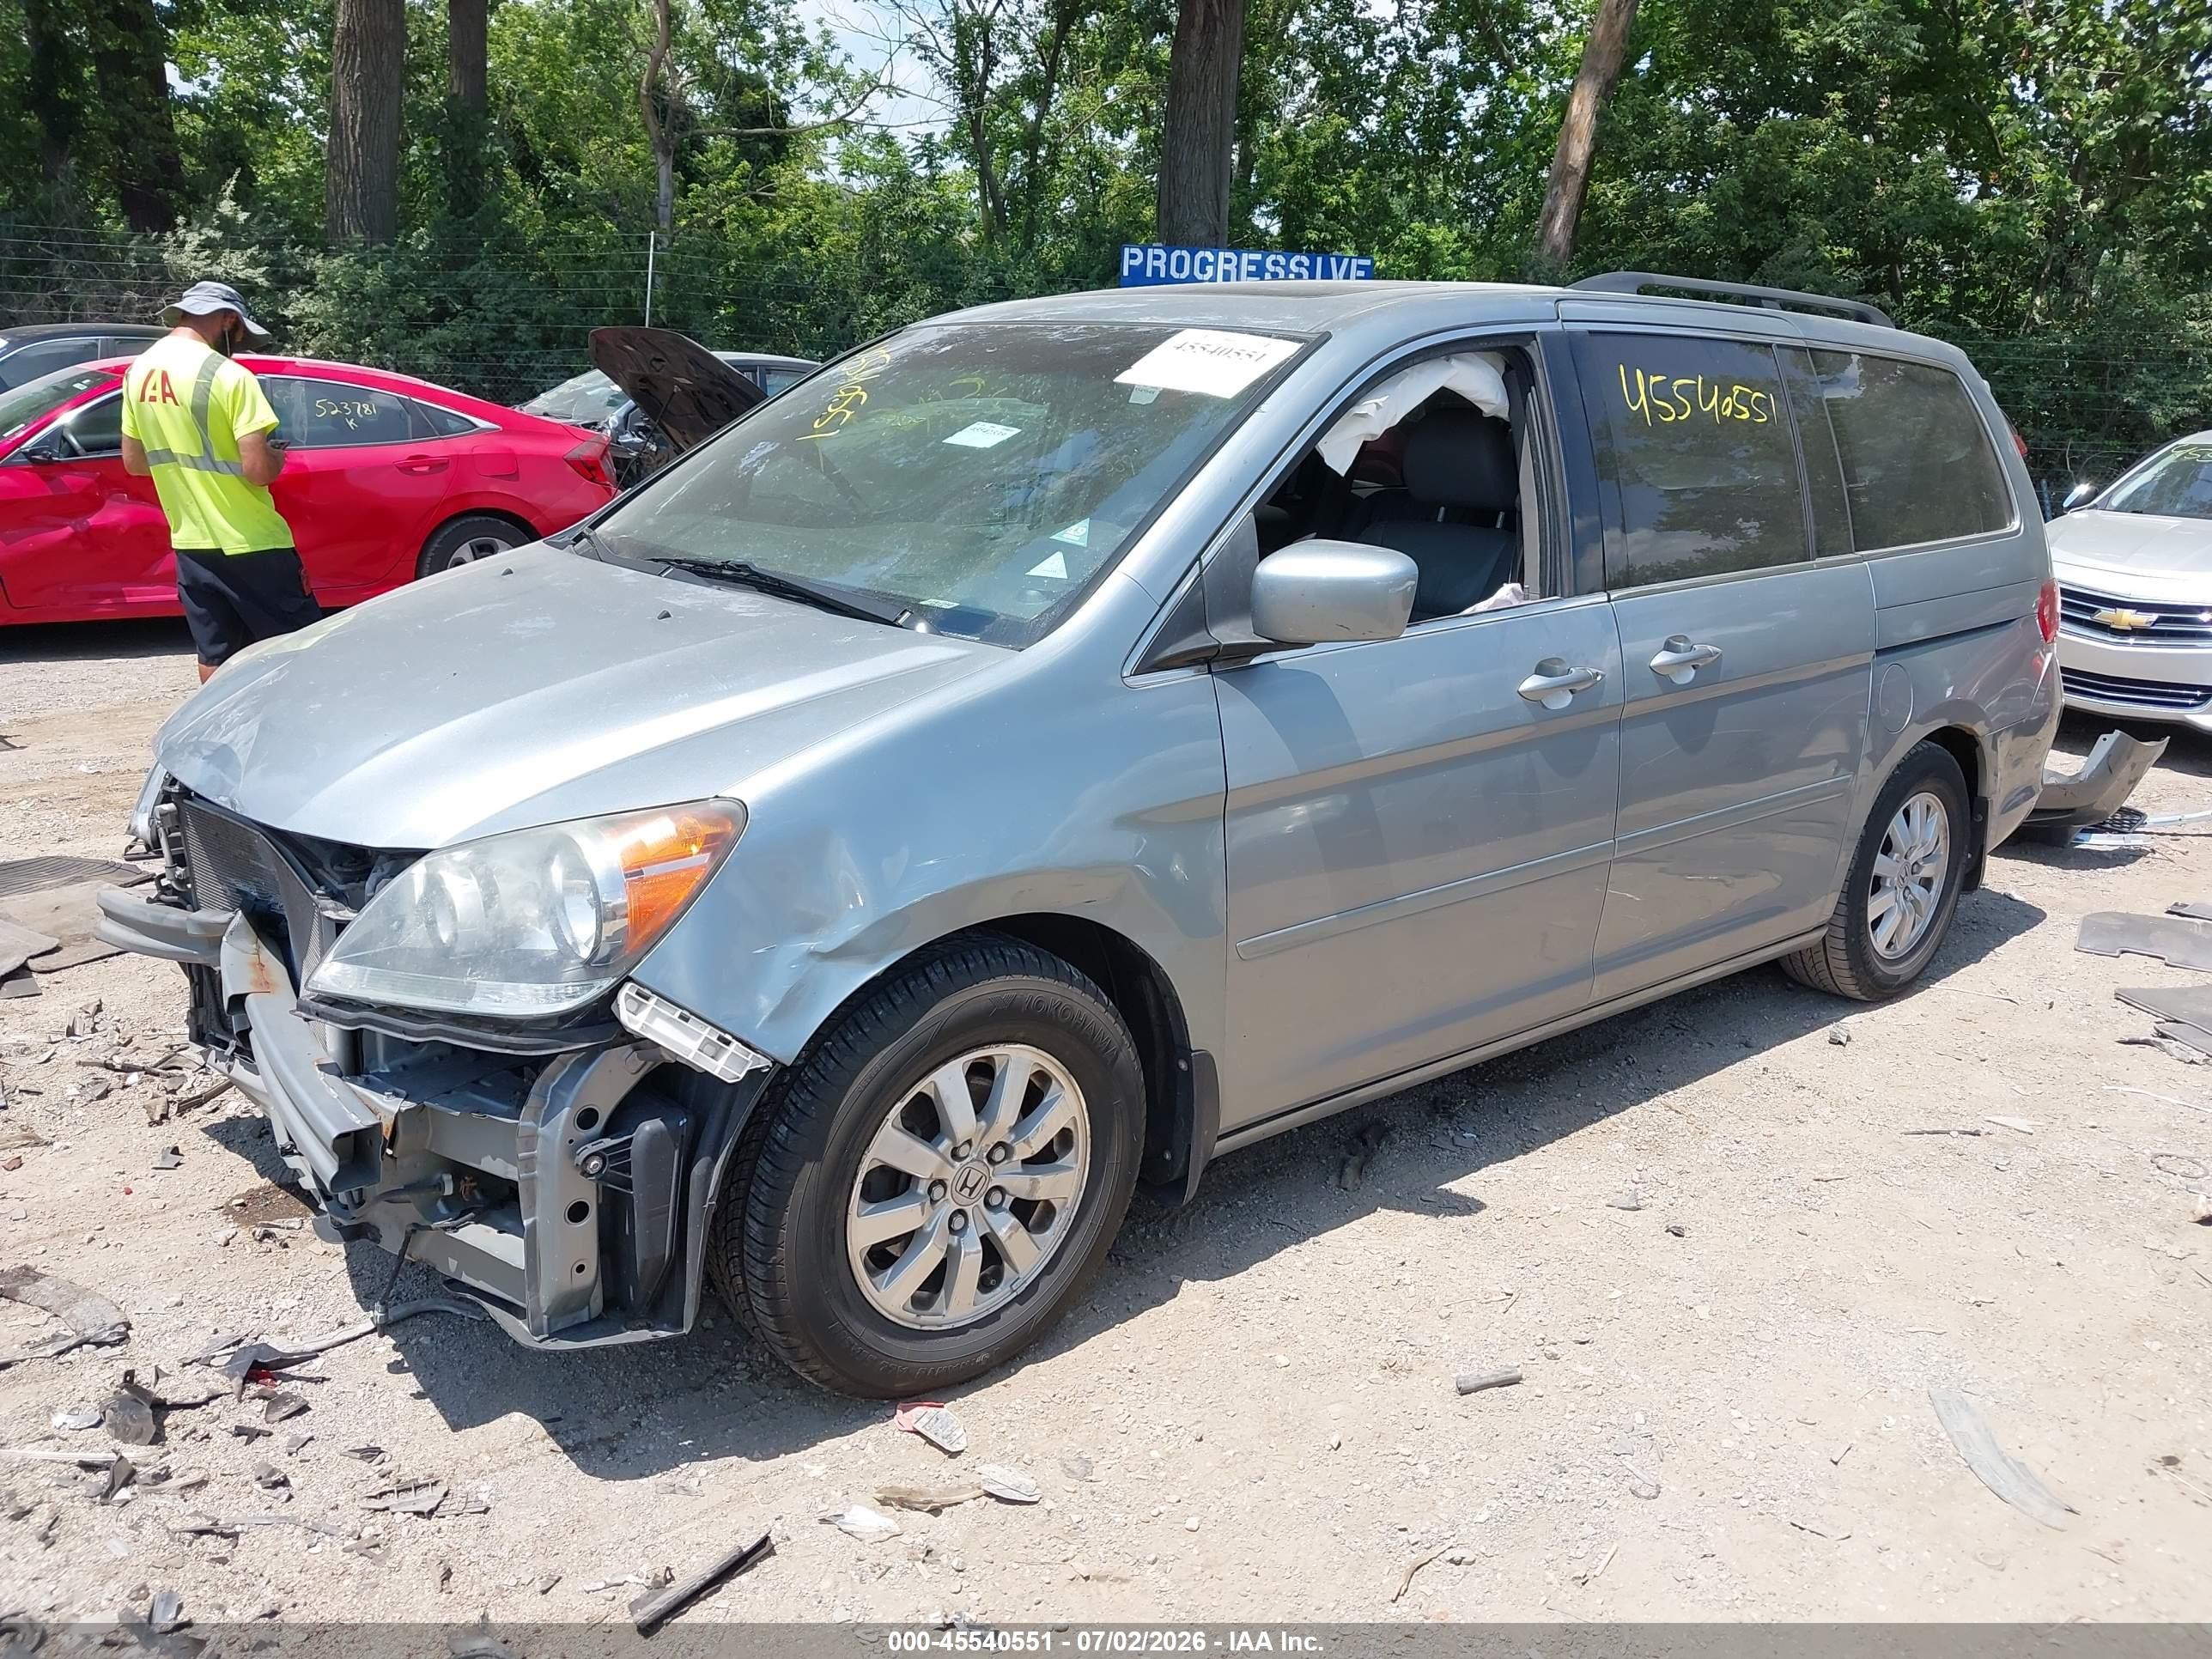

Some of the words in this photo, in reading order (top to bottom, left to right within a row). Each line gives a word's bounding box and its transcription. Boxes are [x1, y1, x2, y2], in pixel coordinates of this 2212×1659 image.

[1122, 246, 1372, 283] PROGRESSIVE
[315, 398, 377, 418] 523781
[1620, 363, 1778, 427] 45540551
[1023, 994, 1120, 1063] YOKOHAMA
